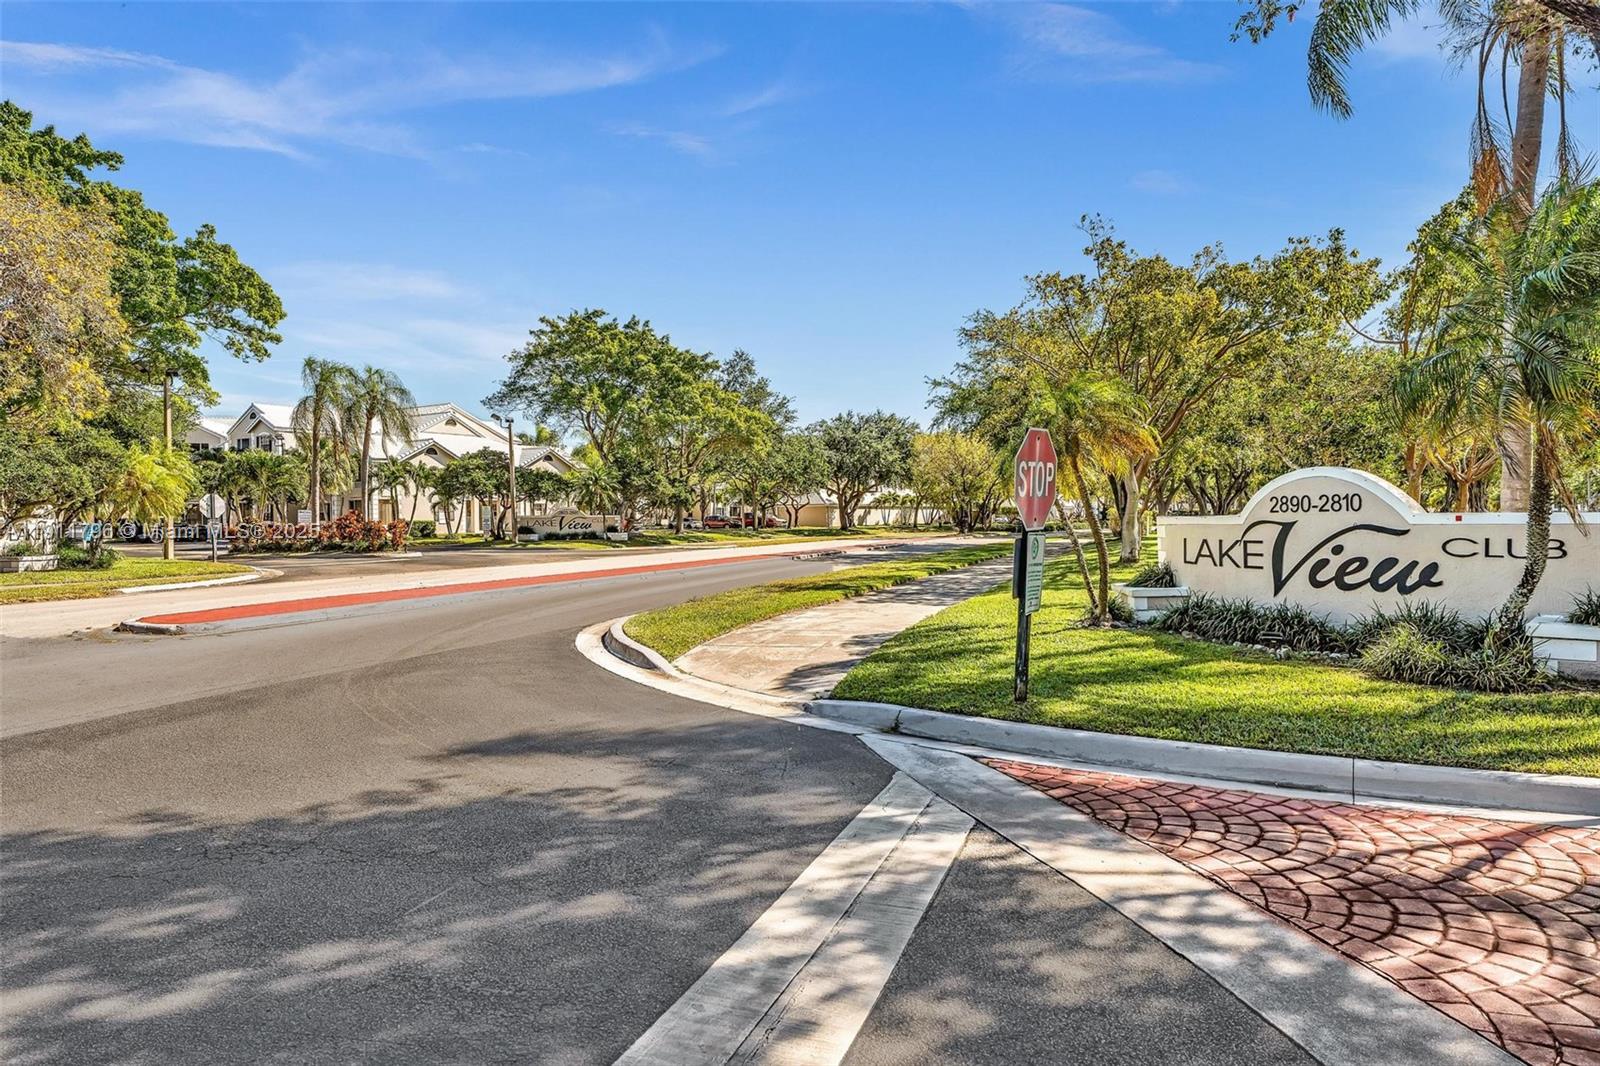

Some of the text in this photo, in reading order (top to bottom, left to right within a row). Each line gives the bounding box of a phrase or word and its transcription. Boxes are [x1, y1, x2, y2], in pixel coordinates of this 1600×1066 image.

[1018, 460, 1055, 498] STOP
[1269, 493, 1362, 514] 2890-2810
[526, 520, 557, 528] LAKE
[551, 515, 593, 531] View
[1183, 519, 1568, 597] LAKE View CLUB
